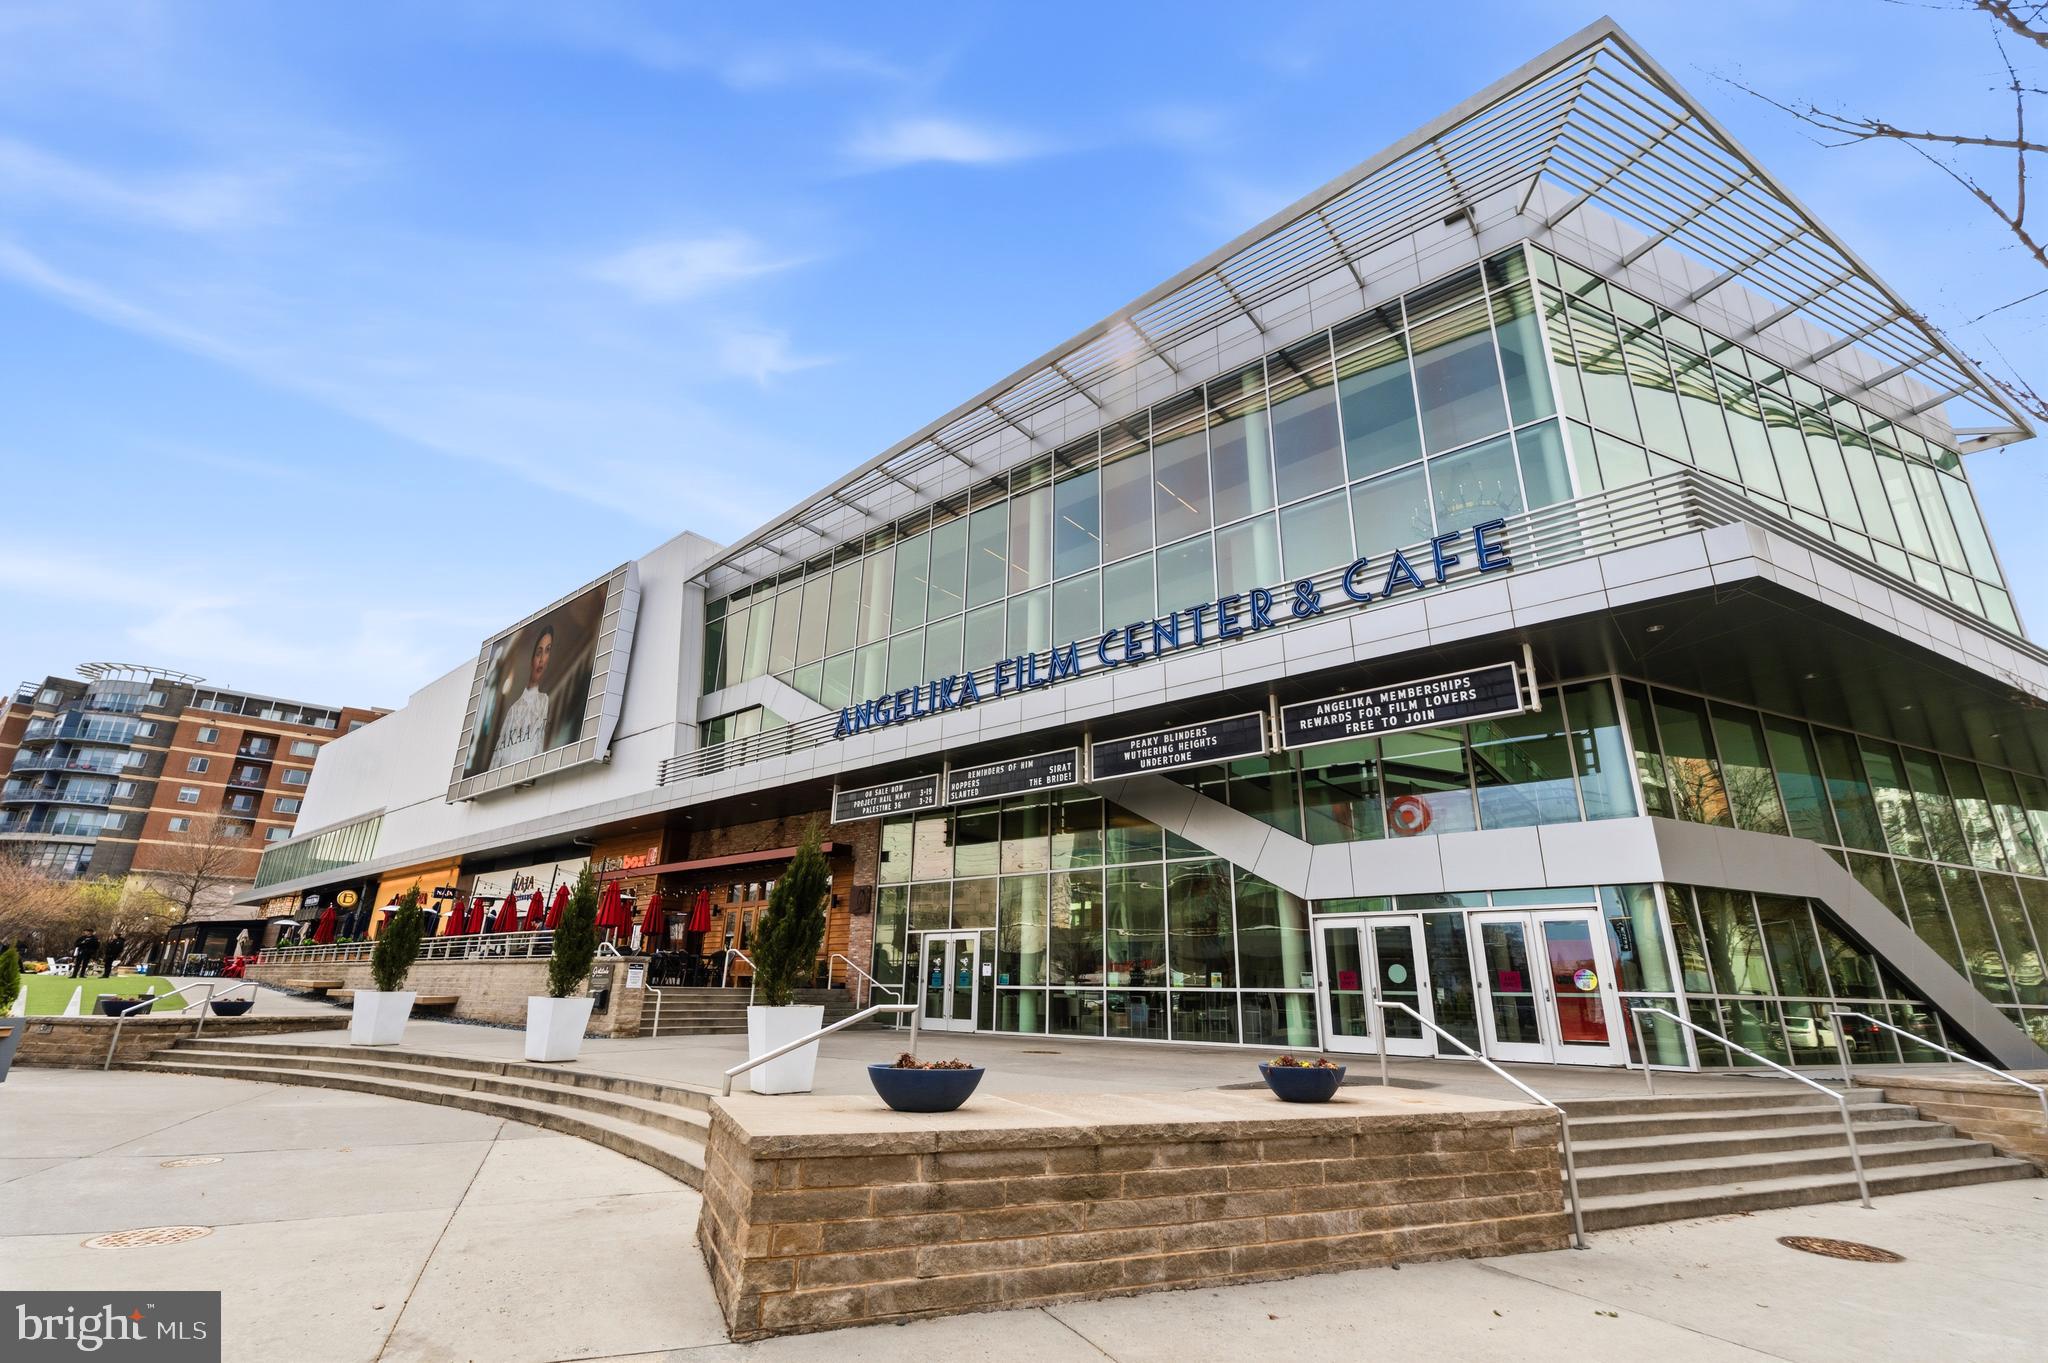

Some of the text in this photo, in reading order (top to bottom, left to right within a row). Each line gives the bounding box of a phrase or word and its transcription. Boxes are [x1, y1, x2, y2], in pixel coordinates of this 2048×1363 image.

[833, 518, 1512, 738] ANGELIKA FILM CENTER & CAFE
[1316, 677, 1471, 715] ANGELIKA MEMBERSHIPS
[1300, 689, 1477, 730] REWARDS FOR FILM LOVERS
[1345, 709, 1435, 734] FREE TO JOIN
[1124, 736, 1218, 761] WUTHERING HEIGHTS
[1130, 727, 1207, 749] PEAKY BLINDERS
[967, 760, 1034, 779] REMINDERS OF HIM
[1140, 751, 1192, 768] UNDERTONE
[951, 762, 1072, 791] HOPPERS SIRAT
[951, 772, 1072, 799] SLANTED THE BRIDE!
[853, 788, 933, 808] PROJECT HAIL MARY 3-19
[875, 787, 888, 796] SALE
[862, 804, 892, 814] PALESTINE
